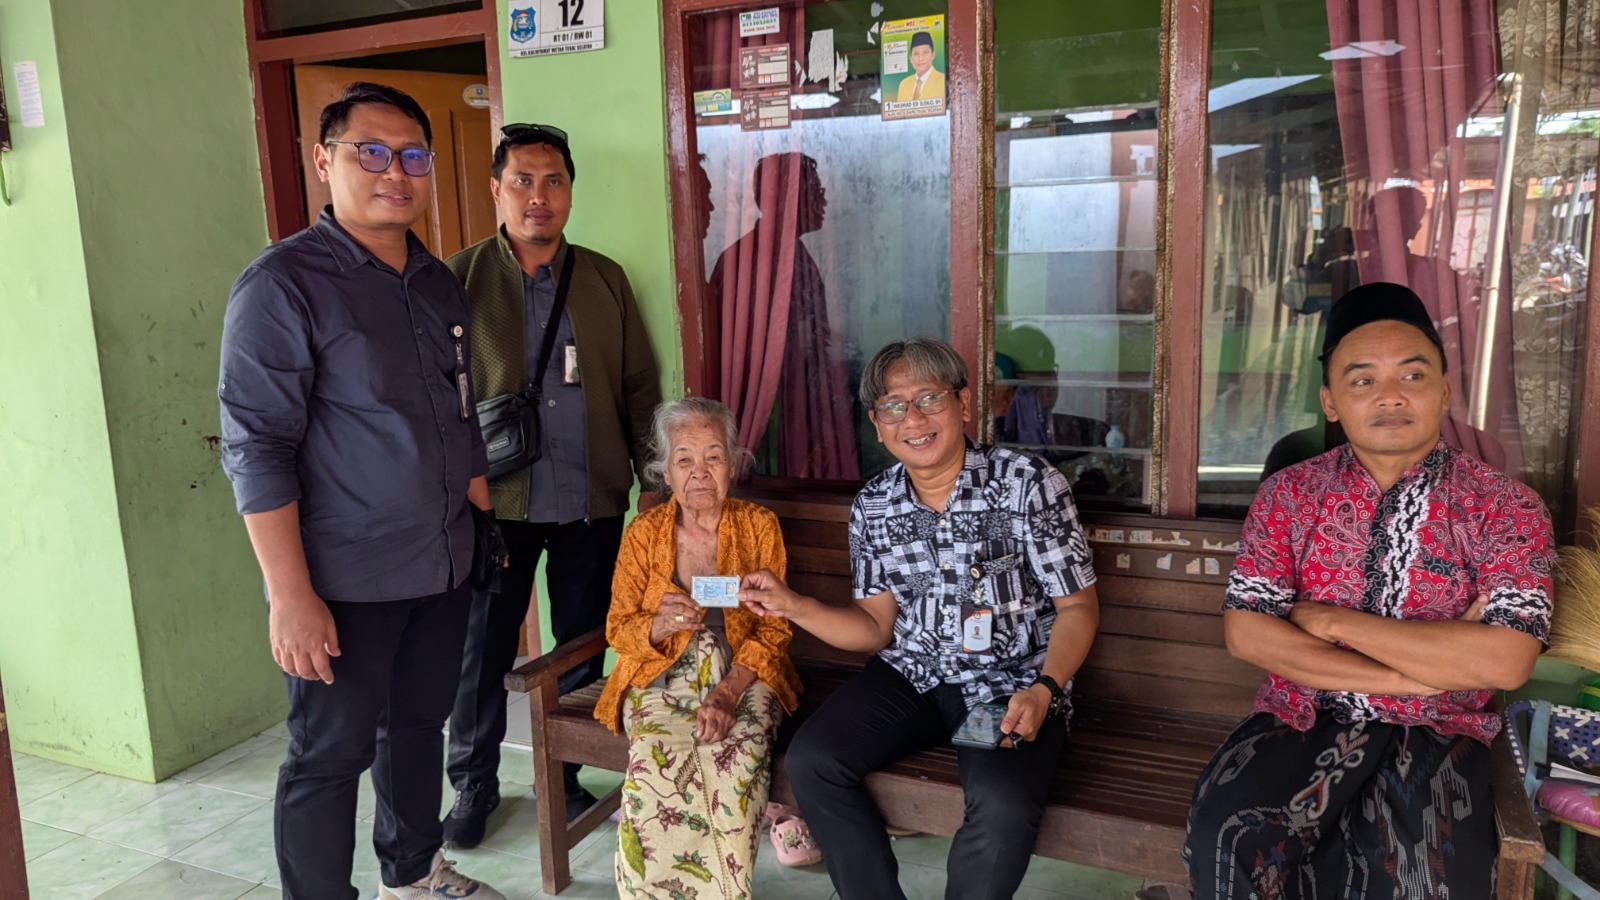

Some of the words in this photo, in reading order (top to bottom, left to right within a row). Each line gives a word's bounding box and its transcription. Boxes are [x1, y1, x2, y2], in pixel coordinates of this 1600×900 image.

[558, 0, 584, 27] 12
[586, 31, 592, 39] 01
[886, 102, 890, 110] 1
